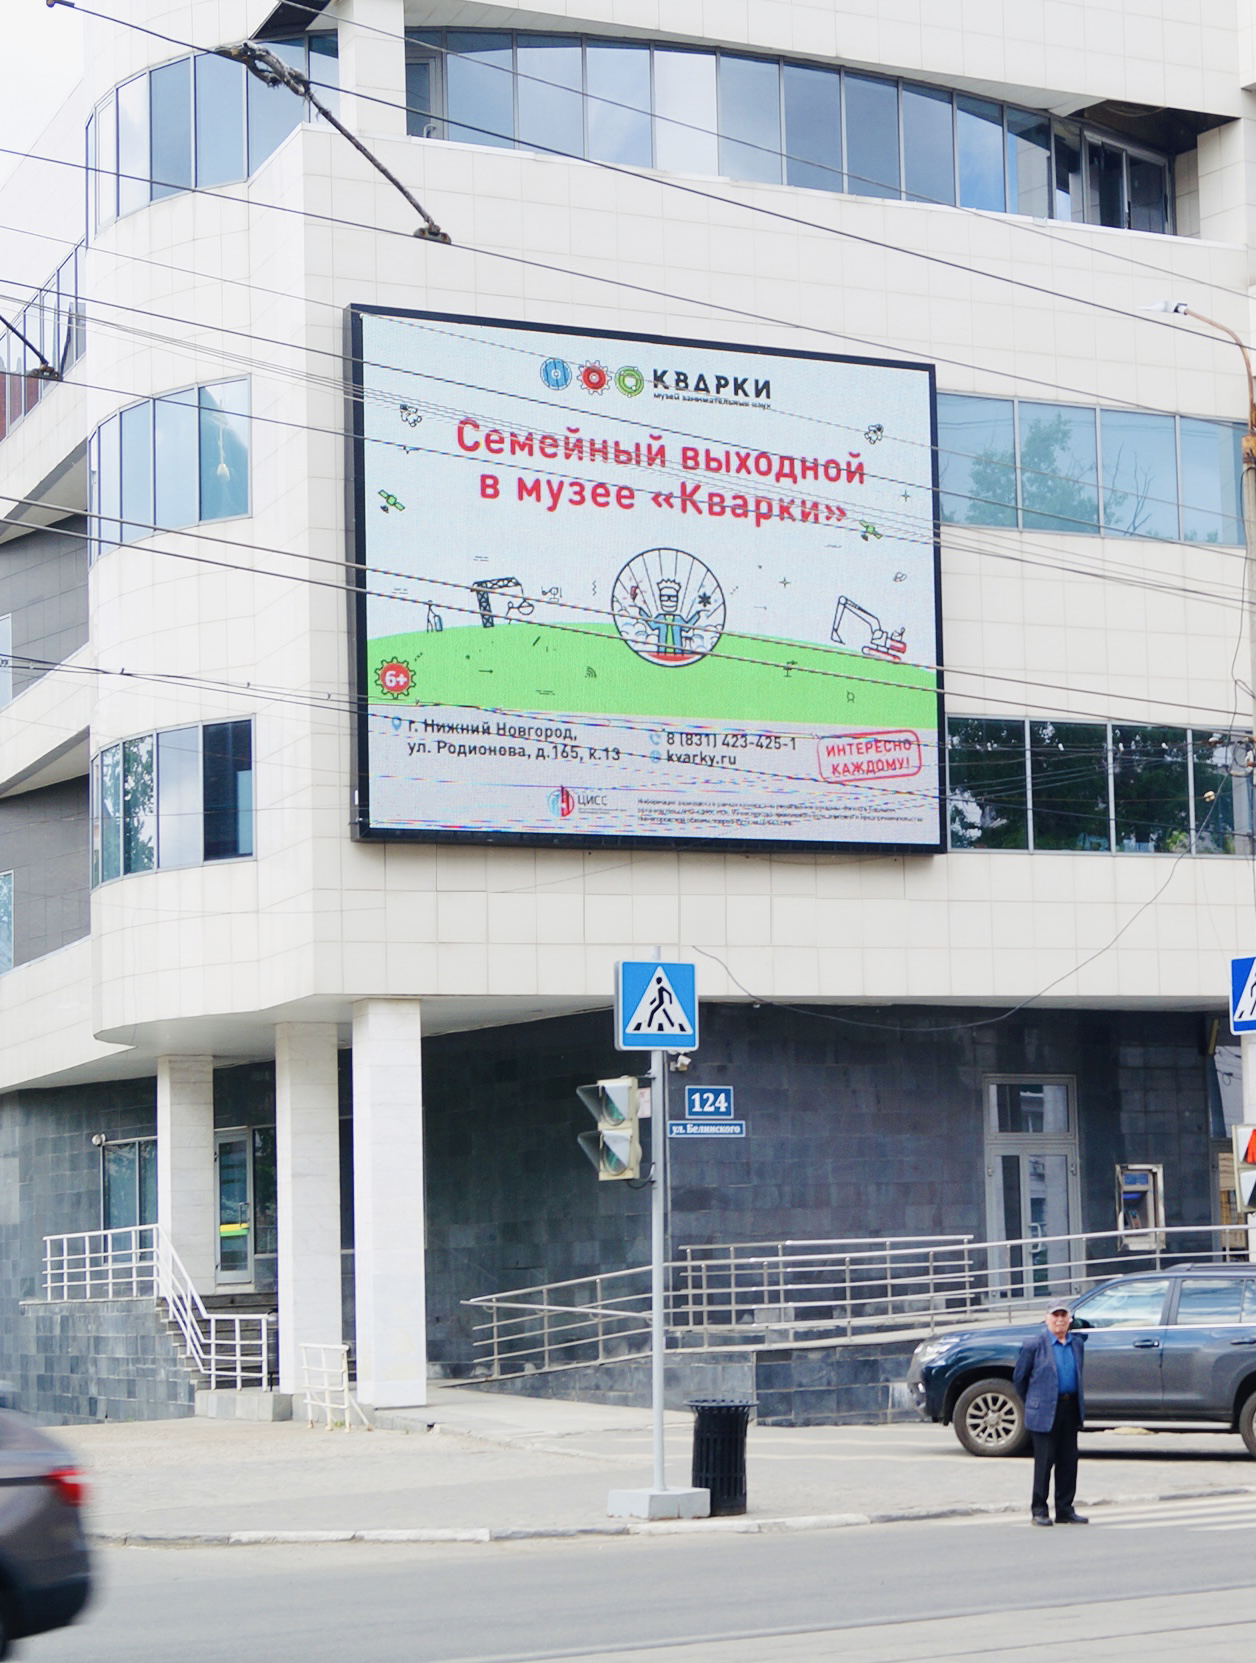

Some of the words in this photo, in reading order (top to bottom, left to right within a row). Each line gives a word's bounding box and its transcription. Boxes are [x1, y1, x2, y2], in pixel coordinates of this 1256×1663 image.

[653, 368, 771, 399] КВАРКИ
[457, 417, 667, 468] Семейный
[681, 446, 865, 485] выходной
[480, 474, 501, 500] в
[517, 476, 636, 512] музее
[651, 481, 847, 528] «Кварки»
[384, 670, 408, 687] 6+
[408, 721, 419, 733] г.
[423, 719, 491, 736] Нижний
[495, 722, 577, 741] Новгород,
[407, 741, 431, 756] ул.
[437, 740, 531, 760] Родионова,
[666, 733, 675, 746] 8
[680, 733, 717, 749] (831)
[722, 734, 796, 751] 423-425-1
[825, 738, 912, 758] ИНТЕРЕСНО
[666, 750, 737, 766] kvarky.ru
[831, 757, 910, 776] КАЖДОМУ!
[577, 795, 608, 807] ЦИСС
[691, 1092, 728, 1112] 124
[672, 1124, 685, 1135] ул.
[686, 1123, 741, 1134] Белинского
